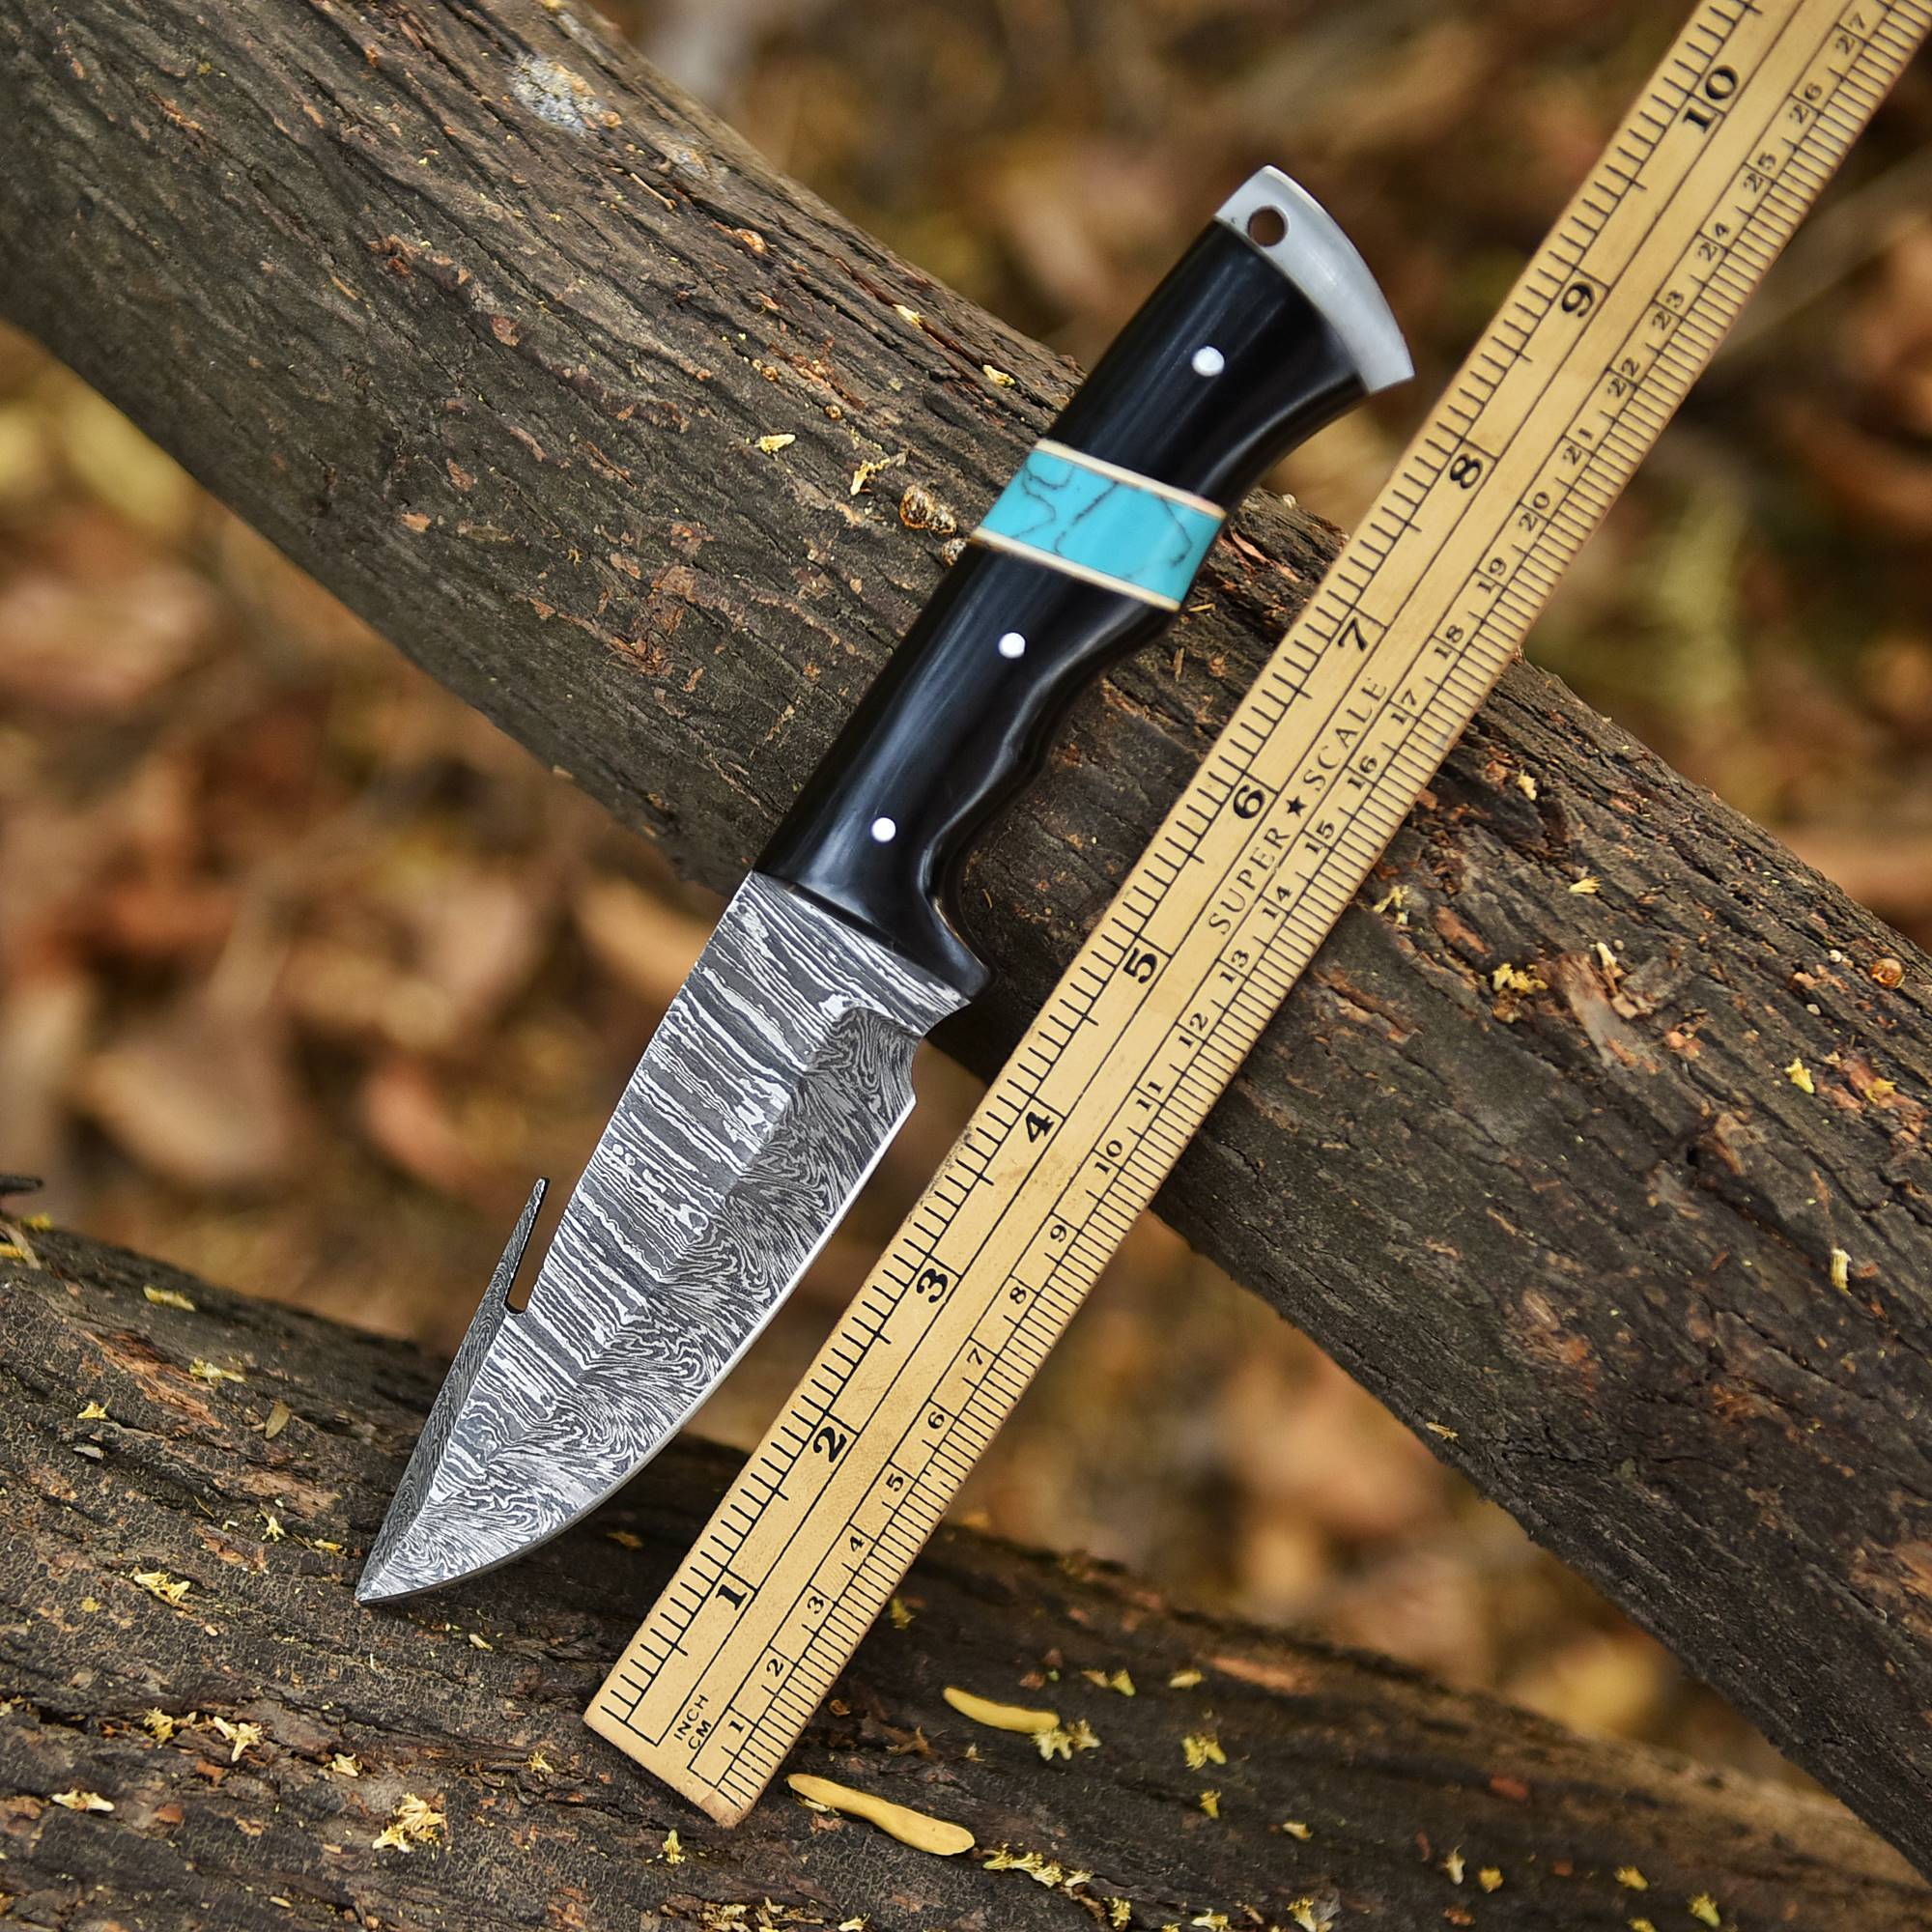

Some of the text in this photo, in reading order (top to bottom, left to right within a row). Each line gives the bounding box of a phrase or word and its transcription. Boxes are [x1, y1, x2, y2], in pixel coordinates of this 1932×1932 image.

[1836, 13, 1866, 54] 27
[1682, 65, 1739, 134] 10
[1789, 83, 1823, 125] 26
[1744, 153, 1776, 192] 25
[1698, 222, 1730, 262] 24
[1561, 280, 1596, 318] 9
[1652, 291, 1685, 330] 23
[1607, 358, 1640, 398] 22
[1563, 427, 1594, 465] 21
[1450, 453, 1483, 490] 8
[1519, 491, 1550, 531] 20
[1477, 557, 1507, 595] 19
[1338, 617, 1370, 652] 7
[1435, 624, 1464, 660] 18
[1391, 689, 1418, 726] 17
[1348, 755, 1378, 792] 16
[1208, 676, 1387, 935] SUPER SCALE
[1234, 784, 1265, 819] 6
[1305, 821, 1335, 855] 15
[1262, 885, 1293, 921] 14
[1123, 948, 1158, 984] 5
[1219, 950, 1249, 984] 13
[1178, 1012, 1208, 1049] 12
[1136, 1081, 1165, 1113] 11
[1025, 1110, 1054, 1143] 4
[1095, 1140, 1124, 1176] 10
[1050, 1225, 1068, 1243] 9
[916, 1267, 949, 1303] 3
[1009, 1288, 1027, 1305] 8
[967, 1349, 983, 1365] 7
[928, 1412, 946, 1430] 6
[813, 1426, 847, 1463] 2
[887, 1474, 905, 1492] 5
[850, 1537, 865, 1554] 4
[717, 1582, 749, 1610] 1
[808, 1596, 825, 1614] 3
[767, 1659, 783, 1676] 2
[674, 1694, 709, 1741] INCH
[688, 1719, 712, 1750] CM
[728, 1719, 746, 1733] 1
